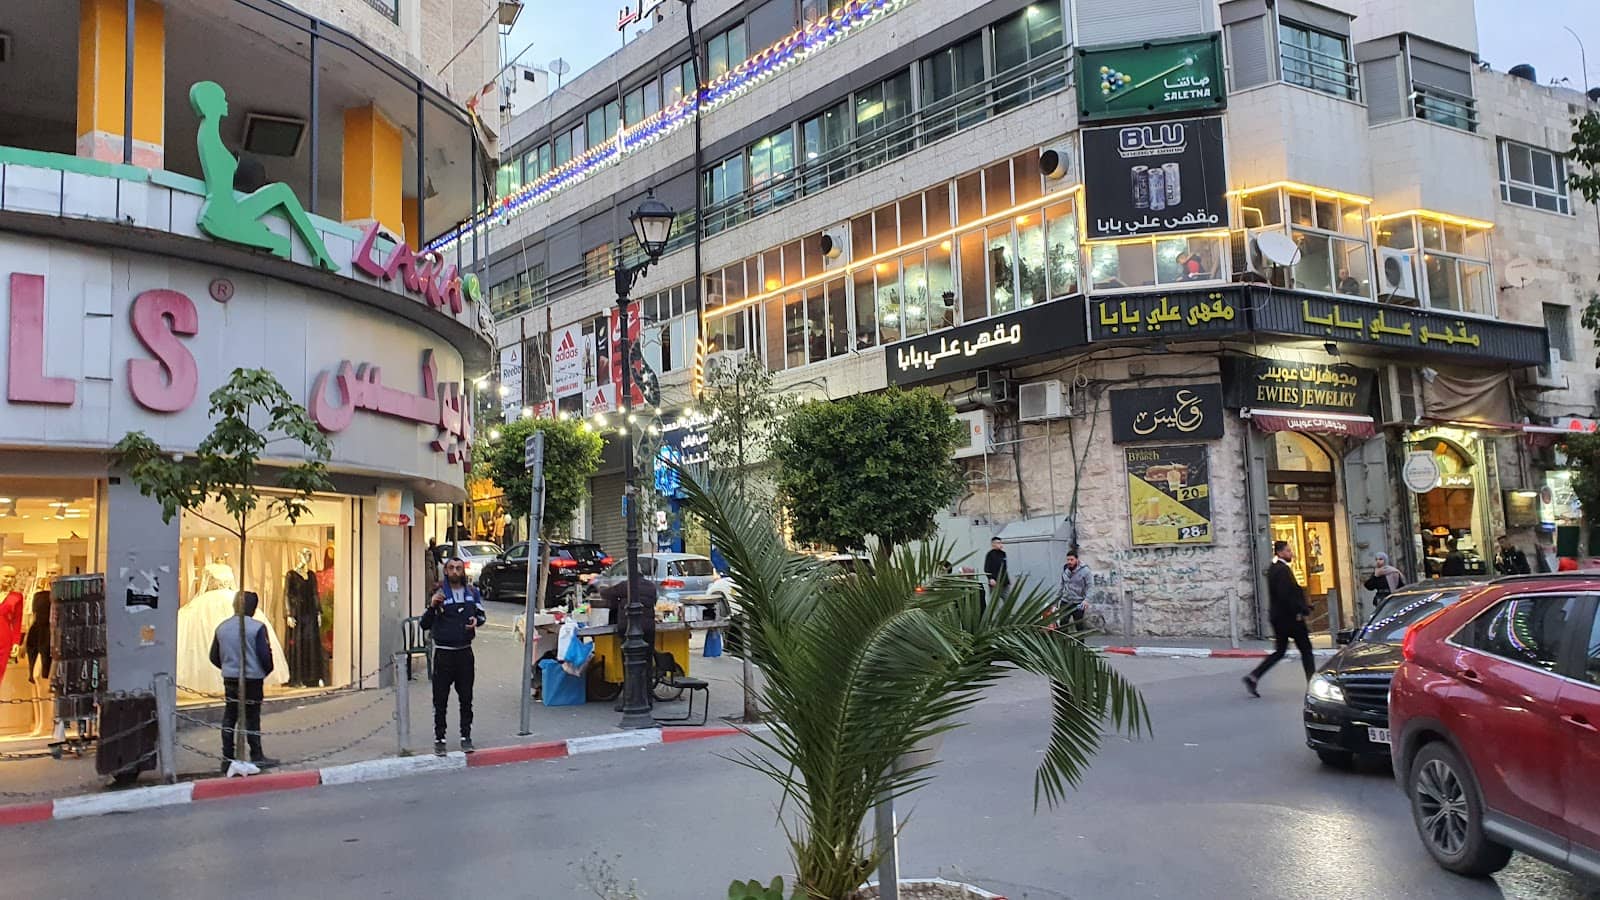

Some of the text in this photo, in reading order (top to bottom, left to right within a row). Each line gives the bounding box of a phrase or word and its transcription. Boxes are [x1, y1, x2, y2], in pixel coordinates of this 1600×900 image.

[1164, 76, 1210, 89] صالتنا
[1164, 89, 1211, 101] SALETNA
[1119, 123, 1185, 150] BLU
[1097, 209, 1219, 236] مقهى علي بابا
[351, 221, 463, 314] LARA
[1100, 292, 1235, 332] مقهى علي بابا
[1303, 300, 1480, 347] مقهى علي بابا
[555, 350, 579, 363] adidas
[898, 323, 1022, 371] مقهى علي بابا
[1300, 367, 1358, 387] مجوهرات
[1257, 385, 1357, 408] EWIES JEWELRY
[1312, 418, 1348, 431] مجوهرات
[1181, 487, 1199, 500] 20
[1181, 526, 1200, 539] 28
